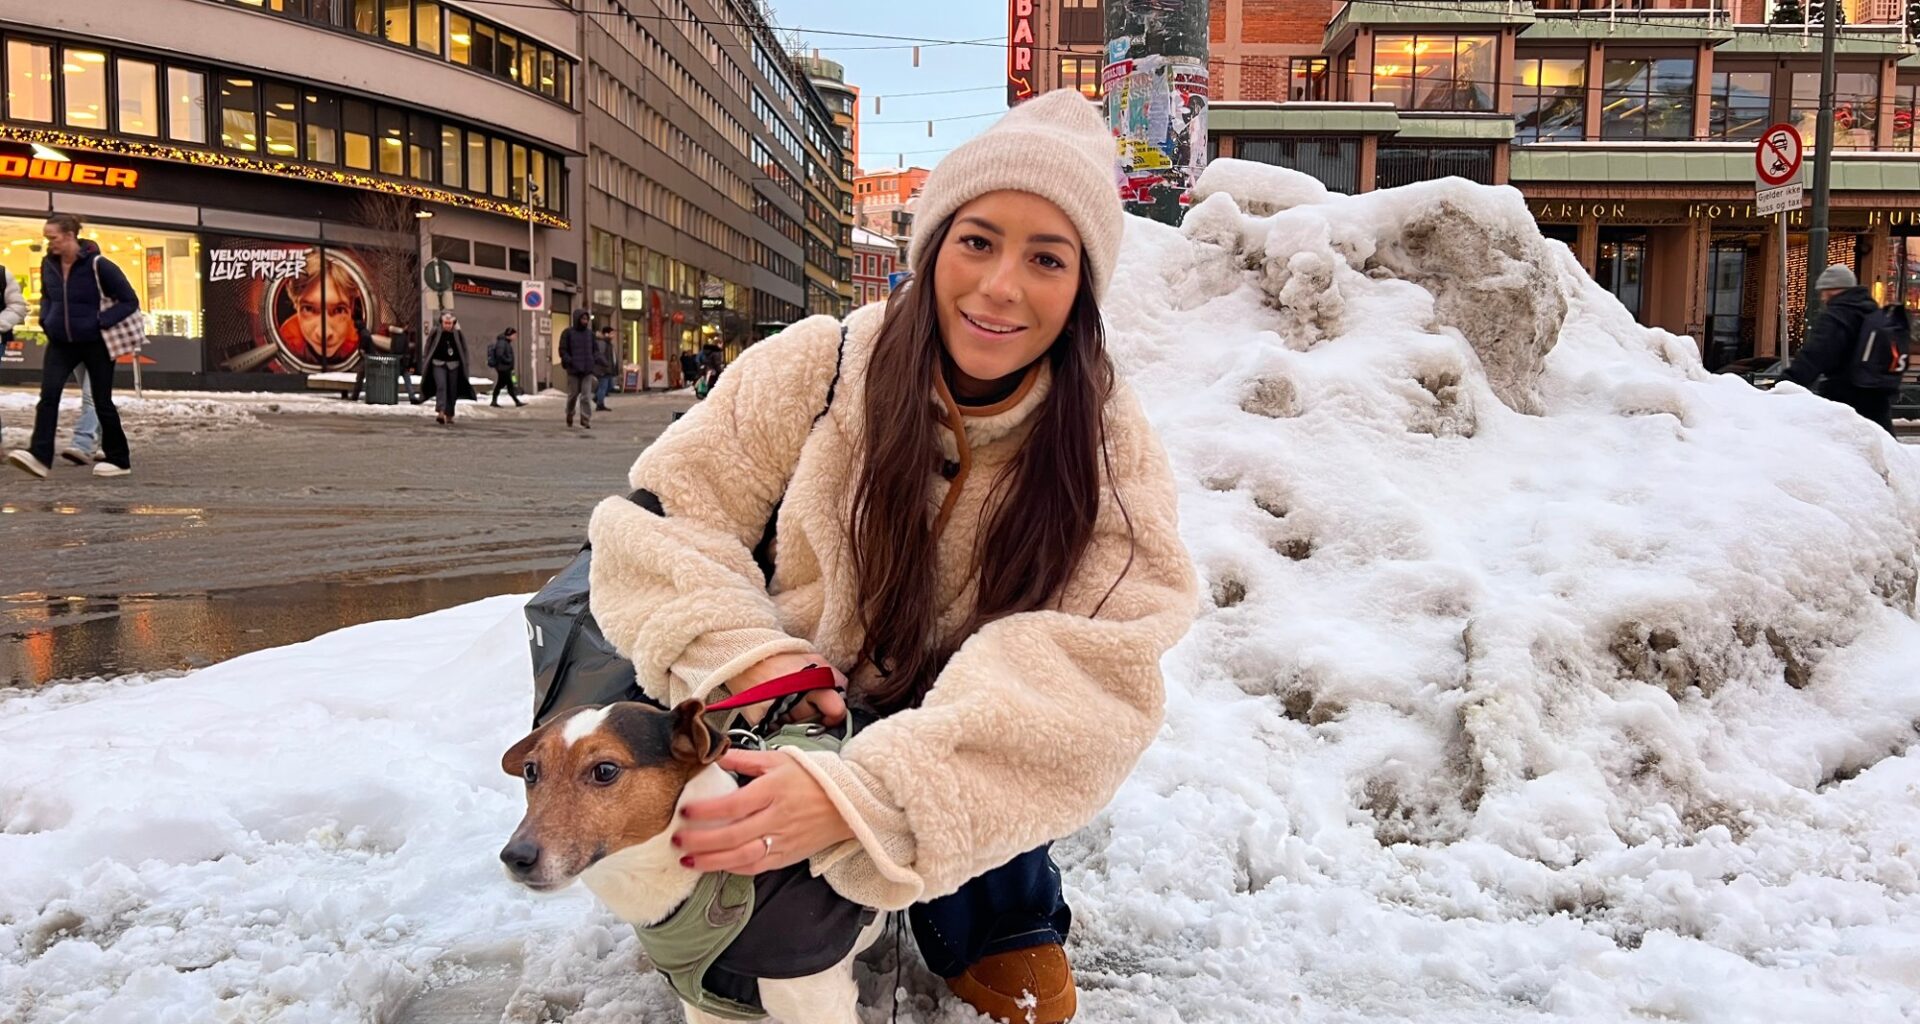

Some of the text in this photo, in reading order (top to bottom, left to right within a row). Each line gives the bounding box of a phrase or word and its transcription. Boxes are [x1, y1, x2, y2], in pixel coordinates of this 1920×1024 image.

[1013, 0, 1033, 71] BAR
[0, 154, 138, 188] OWER
[1758, 186, 1801, 202] Gjelder ikke
[1540, 203, 1625, 218] ARION
[1776, 202, 1786, 211] og
[210, 249, 307, 262] VELKOMMEN TIL
[210, 259, 309, 282] LAVE PRISER
[453, 281, 490, 296] POWER
[525, 281, 542, 289] Sone
